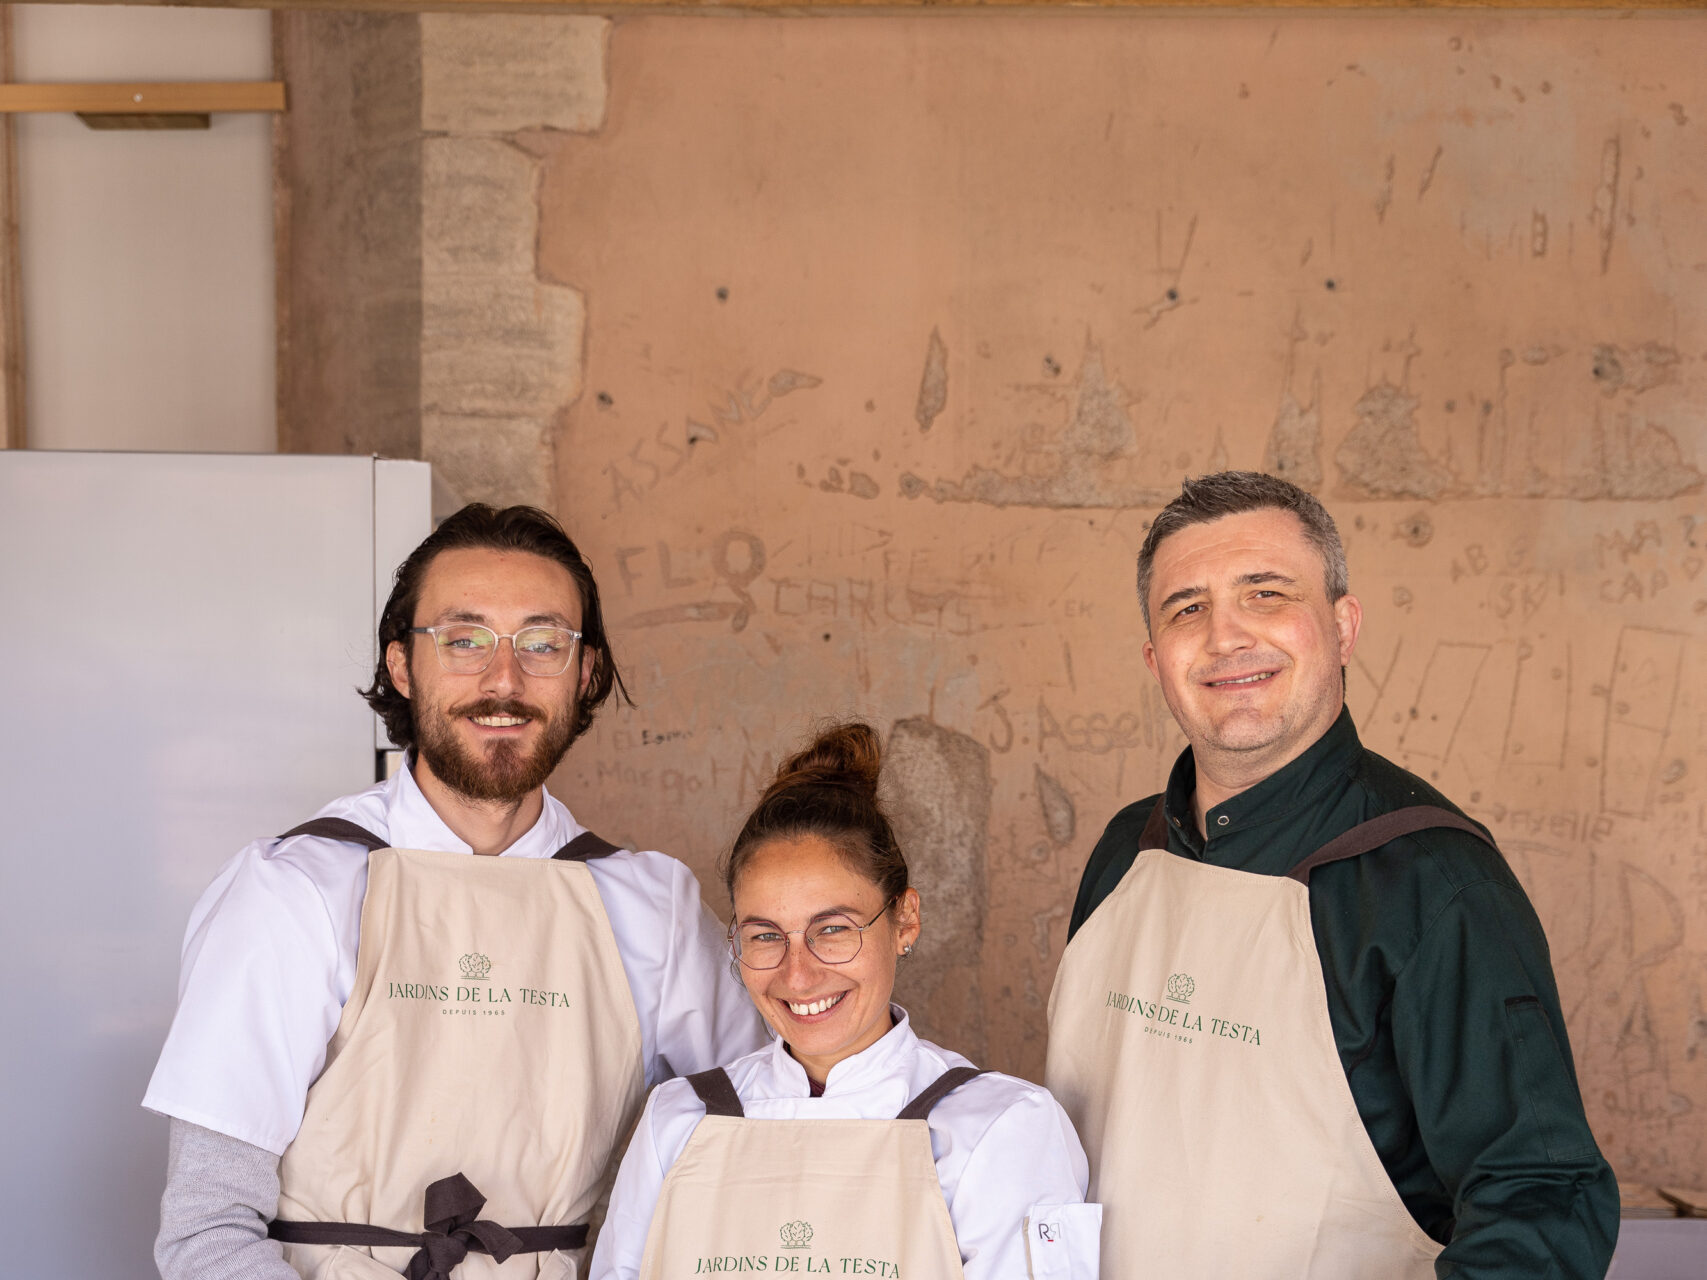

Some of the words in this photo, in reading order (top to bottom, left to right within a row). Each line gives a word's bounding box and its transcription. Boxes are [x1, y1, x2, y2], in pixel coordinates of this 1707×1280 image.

[388, 982, 449, 1002] JARDINS
[456, 986, 481, 1003] DE
[488, 988, 512, 1003] LA
[519, 988, 570, 1008] TESTA
[1105, 990, 1157, 1019] JARDINS
[1157, 1006, 1179, 1026] DE
[1182, 1012, 1202, 1032] LA
[1211, 1018, 1261, 1046] TESTA
[1144, 1026, 1171, 1039] DEPUIS
[694, 1255, 768, 1275] JARDINS
[775, 1256, 800, 1272] DE
[806, 1257, 831, 1273] LA
[839, 1257, 900, 1279] TESTA
